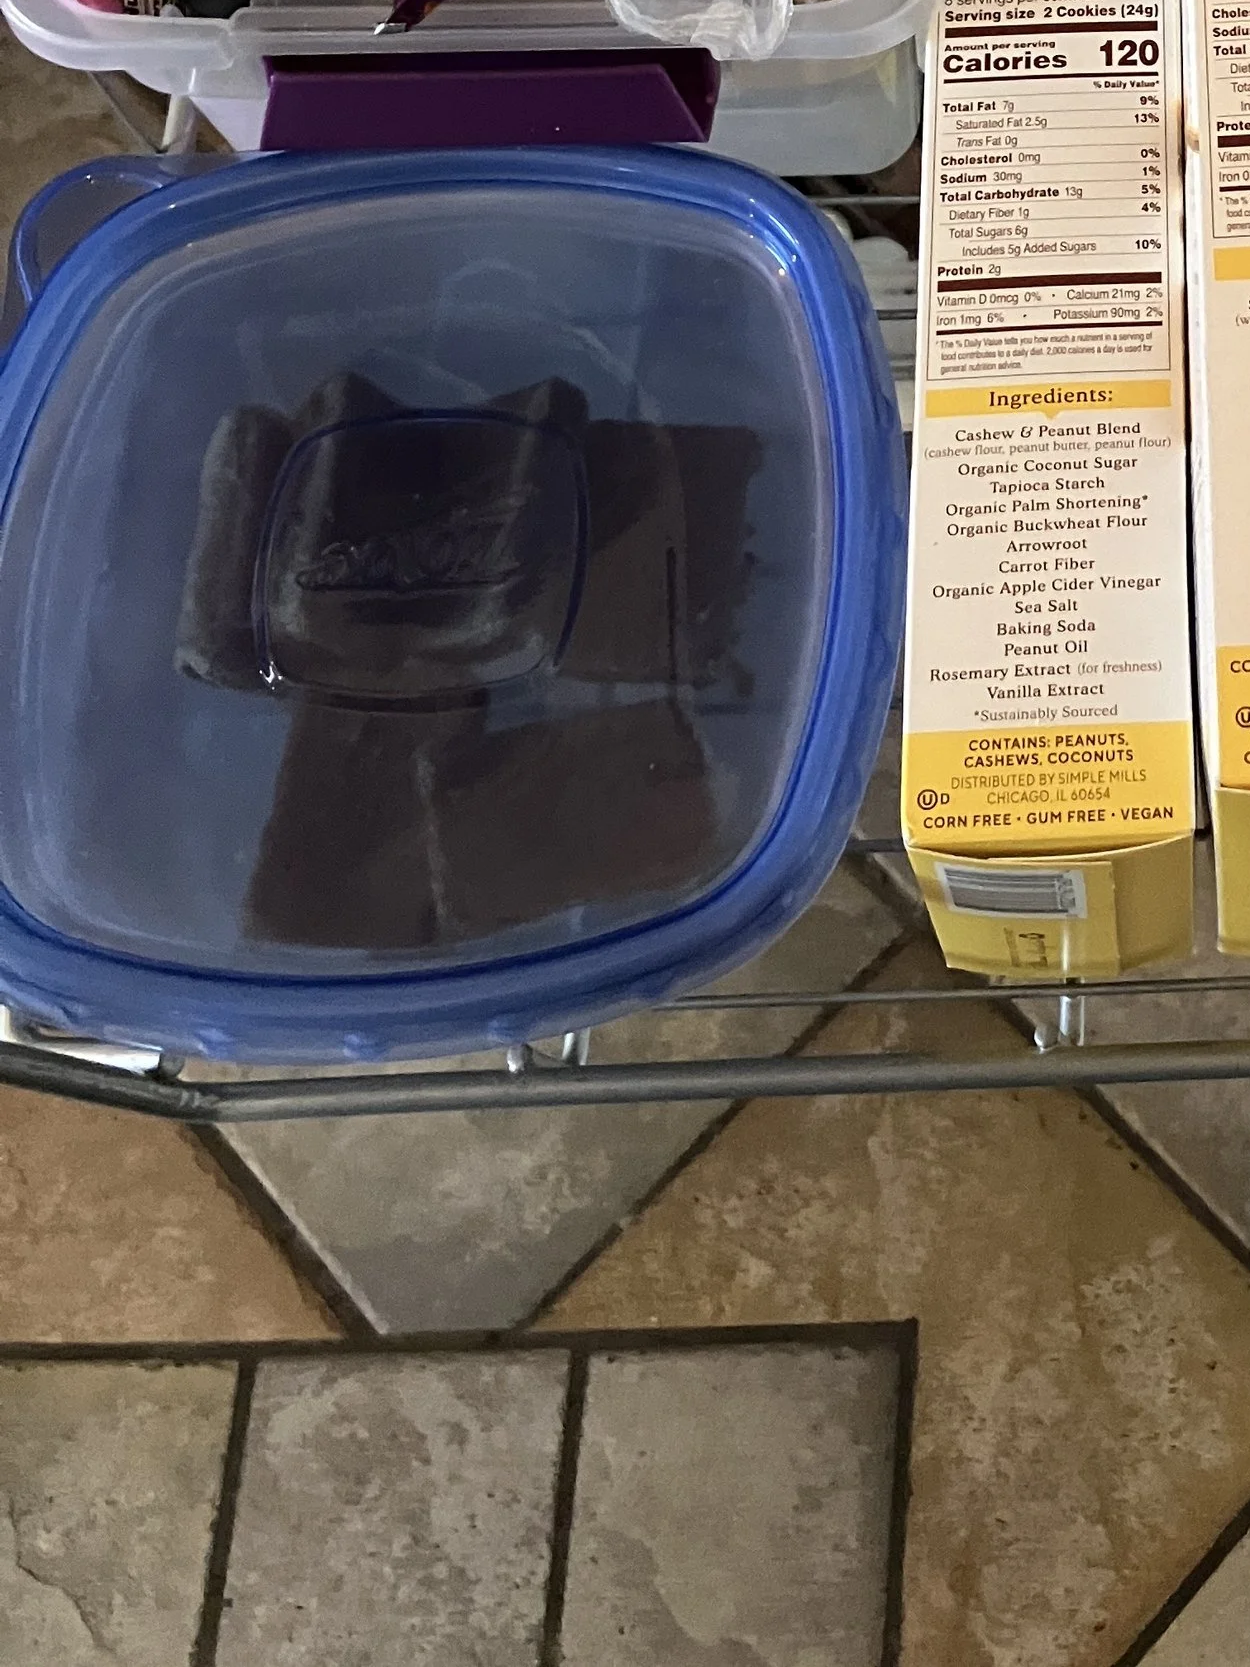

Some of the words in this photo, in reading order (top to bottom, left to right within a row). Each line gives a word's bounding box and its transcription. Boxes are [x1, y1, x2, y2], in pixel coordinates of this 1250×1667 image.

[945, 10, 1001, 23] Serving
[1006, 9, 1035, 18] size
[1044, 7, 1052, 17] 2
[1056, 6, 1116, 17] Cookies
[1121, 4, 1159, 18] (24g)
[943, 53, 1067, 73] Calories
[1100, 40, 1159, 67] 120
[943, 103, 973, 113] Total
[978, 101, 996, 112] Fat
[1003, 101, 1014, 112] 7g
[1140, 96, 1159, 106] 9%
[990, 389, 1113, 410] Ingredients:
[955, 429, 1014, 442] Cashew
[1020, 427, 1033, 438] &
[1039, 425, 1090, 437] Peanut
[1097, 423, 1141, 435] Blend
[990, 481, 1049, 495] Tapioca
[1056, 478, 1105, 490] Starch
[932, 583, 994, 599] Organic
[1000, 582, 1046, 596] Apple
[1052, 577, 1094, 591] Cider
[1100, 577, 1161, 591] Vinegar
[924, 815, 968, 829] CORN
[973, 812, 1012, 826] FREE
[1026, 812, 1062, 824] GUM
[1068, 810, 1106, 824] FREE
[1121, 806, 1174, 821] VEGAN
